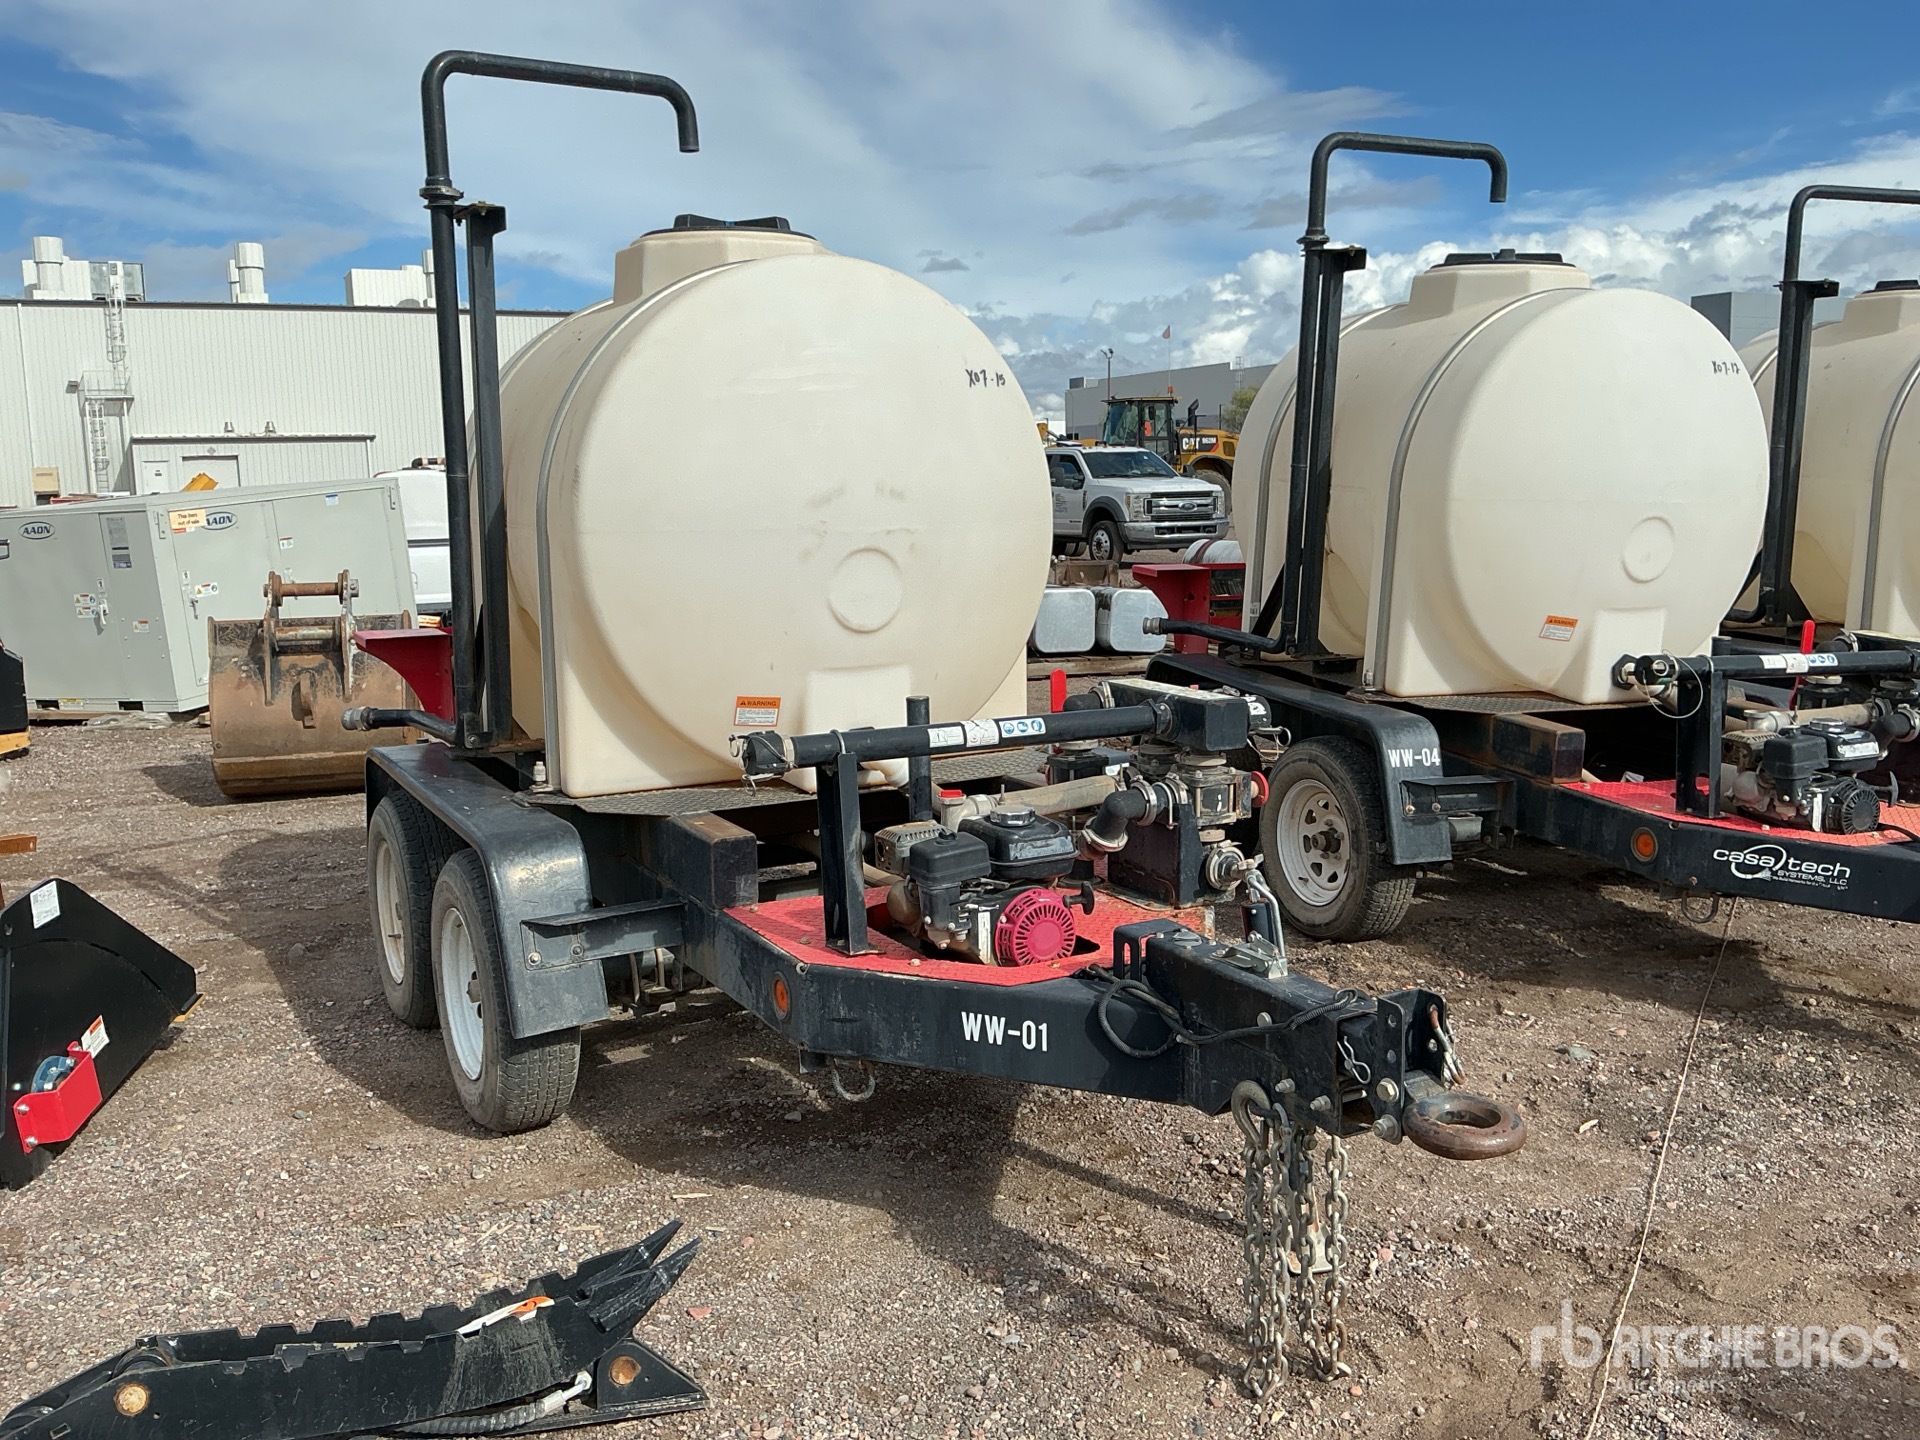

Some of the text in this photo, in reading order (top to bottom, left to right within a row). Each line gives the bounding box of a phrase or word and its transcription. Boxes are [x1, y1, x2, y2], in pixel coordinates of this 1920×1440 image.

[965, 368, 1006, 388] X07-15
[22, 525, 51, 536] AAON
[1387, 747, 1441, 768] WW-04
[1829, 878, 1848, 886] LLC
[961, 1011, 1048, 1052] WW-01
